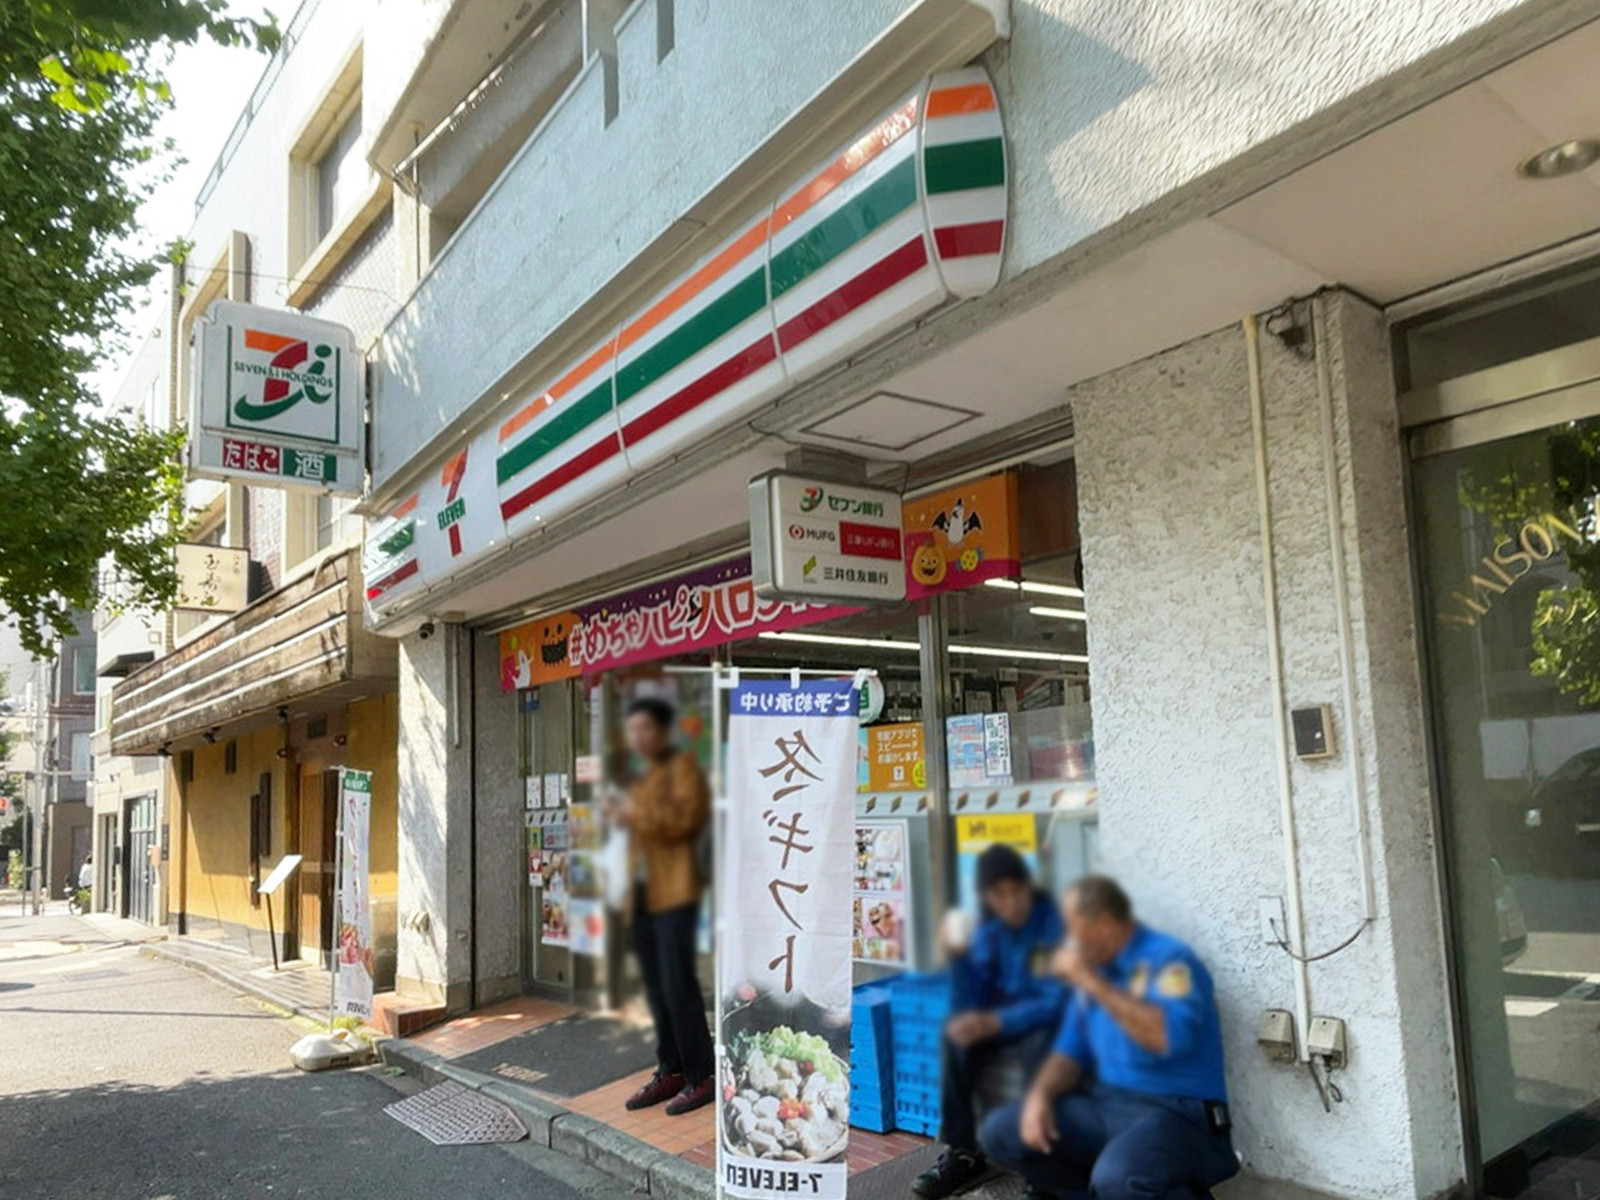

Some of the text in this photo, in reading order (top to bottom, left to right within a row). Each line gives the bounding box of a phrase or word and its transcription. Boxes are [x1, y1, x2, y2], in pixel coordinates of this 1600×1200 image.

[234, 361, 266, 375] SEVEN
[281, 369, 333, 388] HOLDINGS
[225, 439, 278, 473] たばこ
[294, 451, 326, 479] 酒
[828, 494, 884, 518] セブン銀行
[806, 529, 836, 542] MUFG
[823, 566, 888, 585] 三井住友銀行
